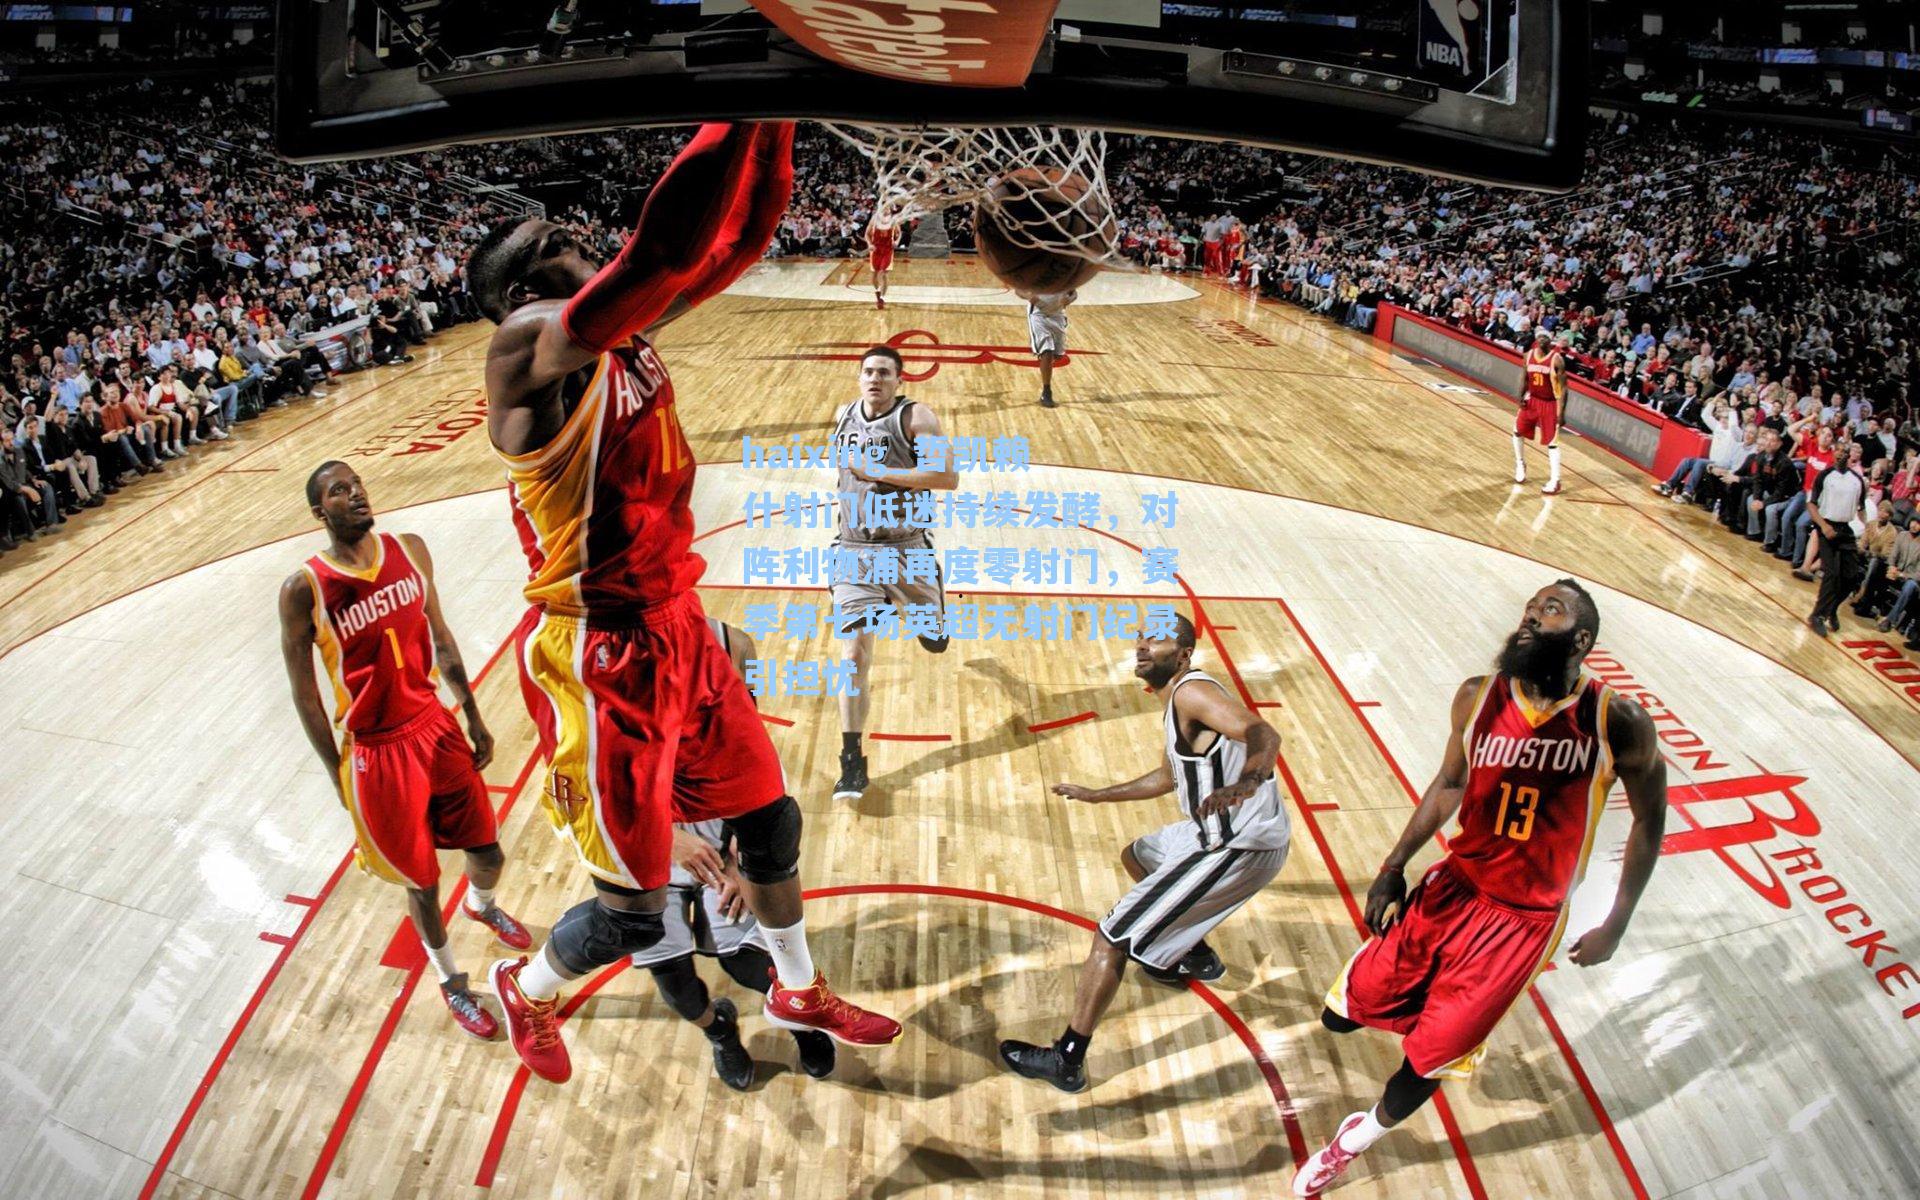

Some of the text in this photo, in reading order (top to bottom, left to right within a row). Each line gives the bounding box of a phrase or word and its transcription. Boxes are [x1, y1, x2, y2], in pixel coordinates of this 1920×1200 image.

[1426, 41, 1461, 67] NBA
[334, 572, 421, 641] HOUSTON
[384, 627, 405, 670] 1
[1472, 732, 1593, 775] HOUSTON
[1493, 781, 1541, 842] 13
